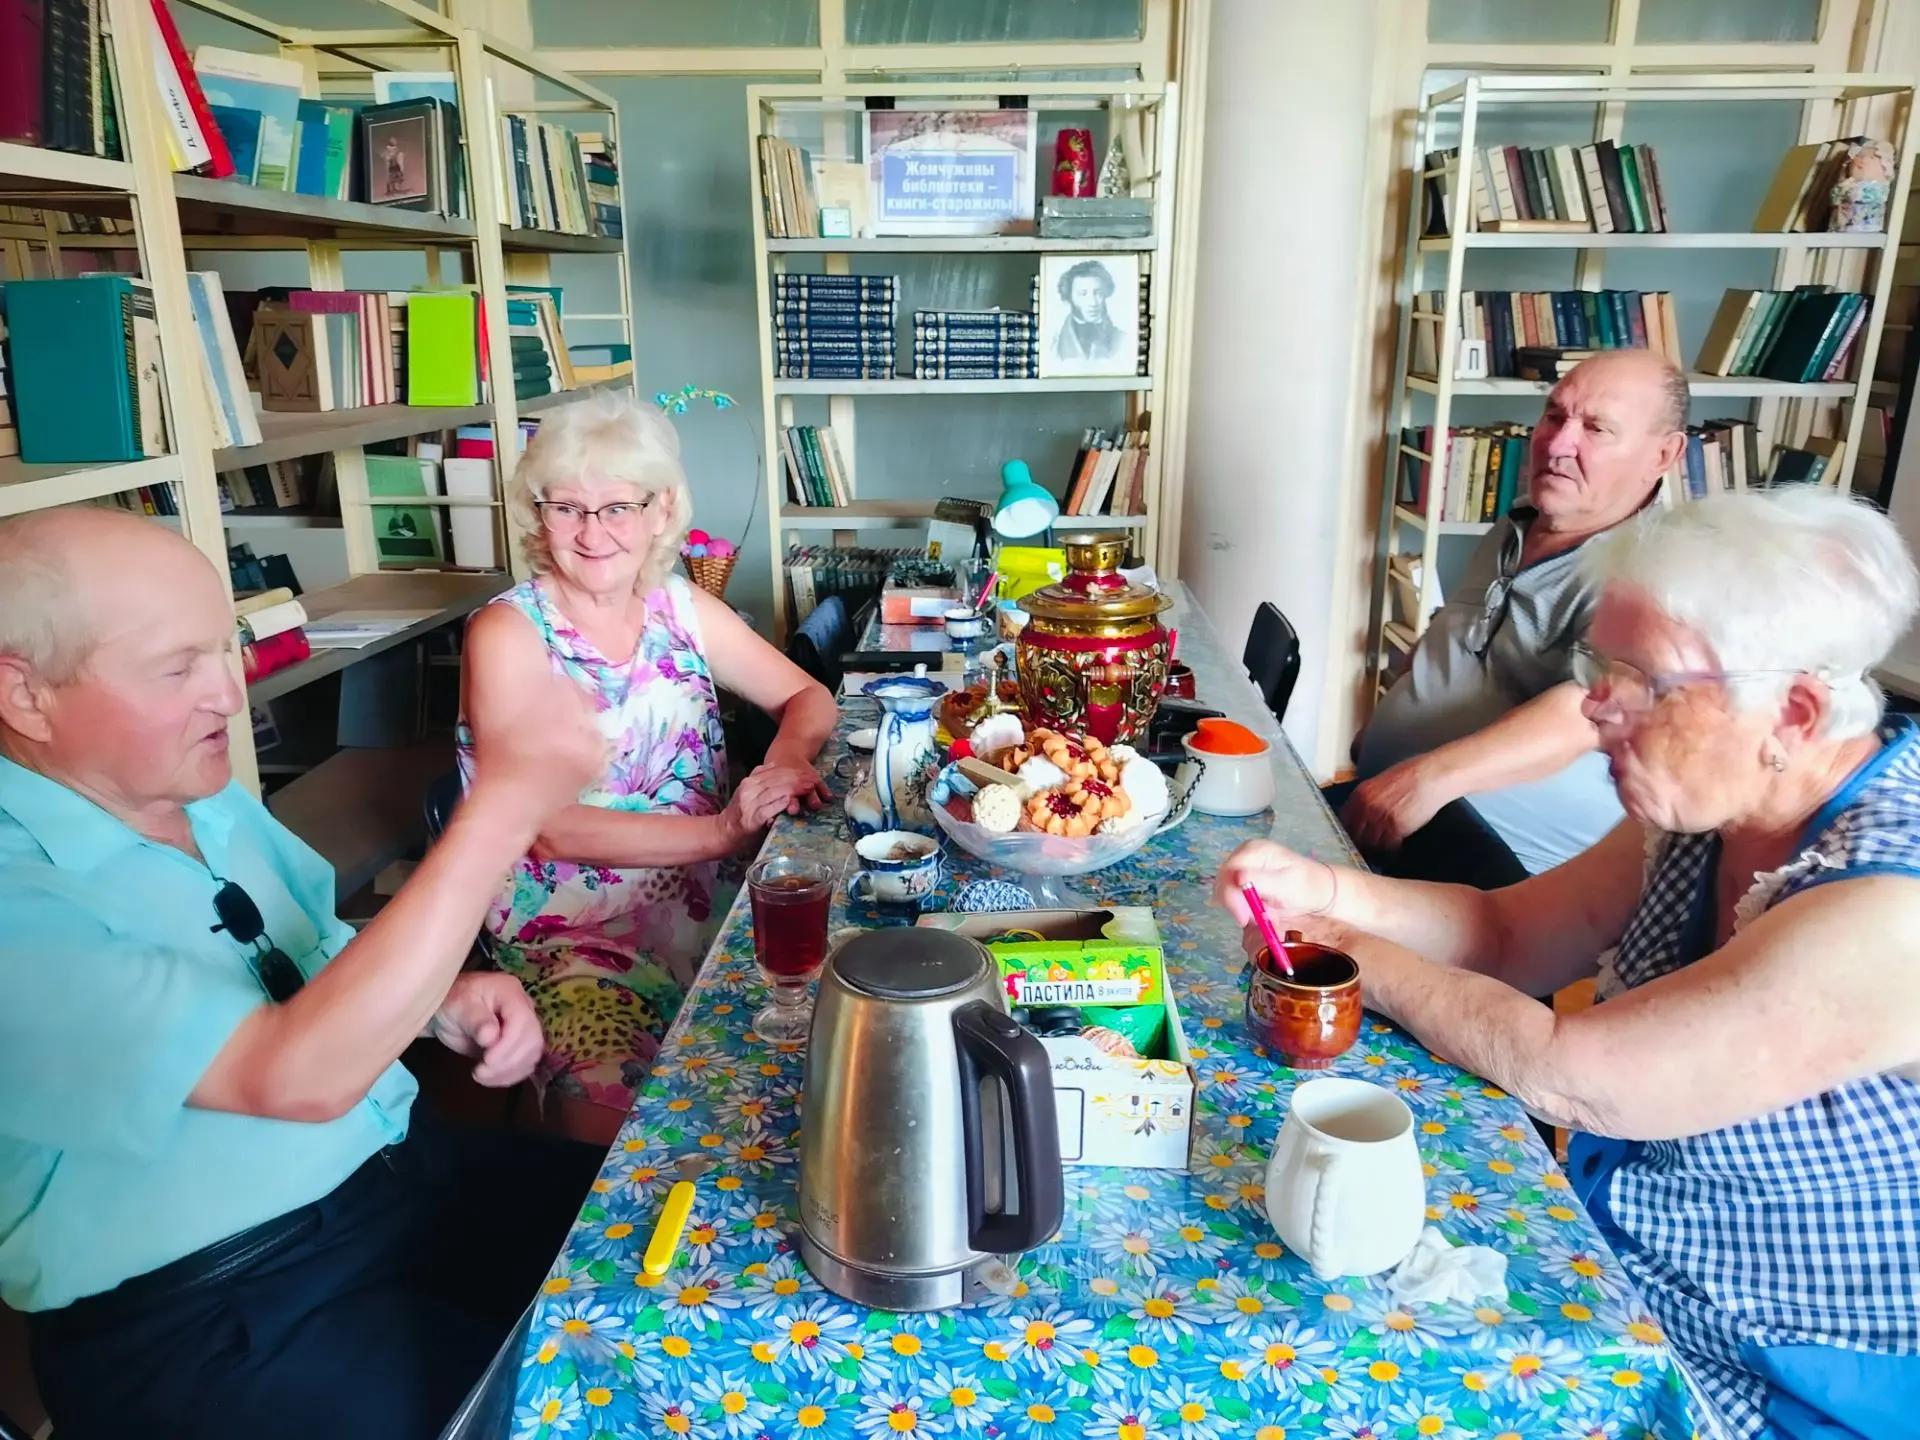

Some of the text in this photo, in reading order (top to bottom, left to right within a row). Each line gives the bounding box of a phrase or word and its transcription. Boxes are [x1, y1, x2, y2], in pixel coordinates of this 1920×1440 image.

[905, 160, 995, 180] Жемчужины
[902, 178, 985, 193] библиотеки
[886, 198, 1013, 213] книги-старожилы
[1469, 347, 1479, 370] П
[1023, 984, 1095, 1003] ПАСТИЛА
